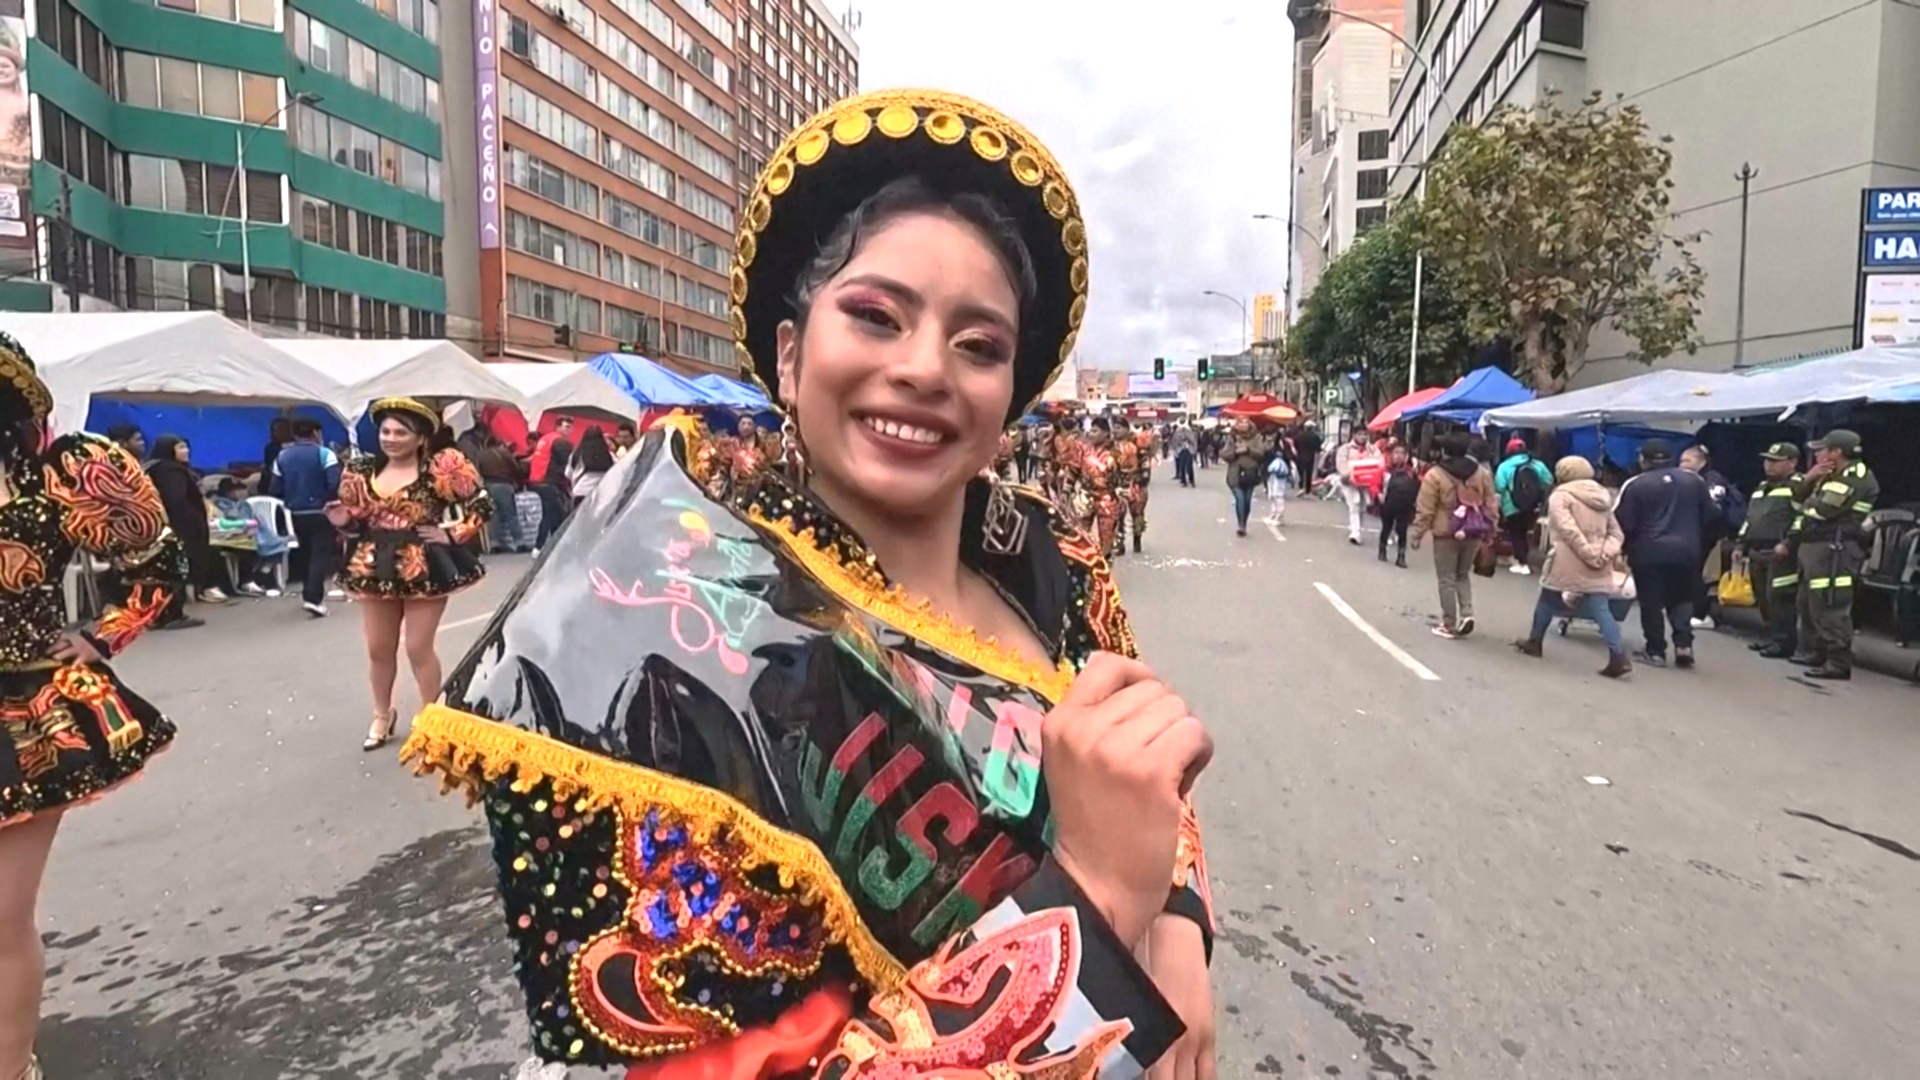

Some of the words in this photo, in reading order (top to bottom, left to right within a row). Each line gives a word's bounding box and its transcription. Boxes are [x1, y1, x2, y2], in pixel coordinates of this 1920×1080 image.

[481, 84, 497, 202] PACEÑO
[1874, 237, 1920, 260] HA
[1325, 390, 1338, 404] P
